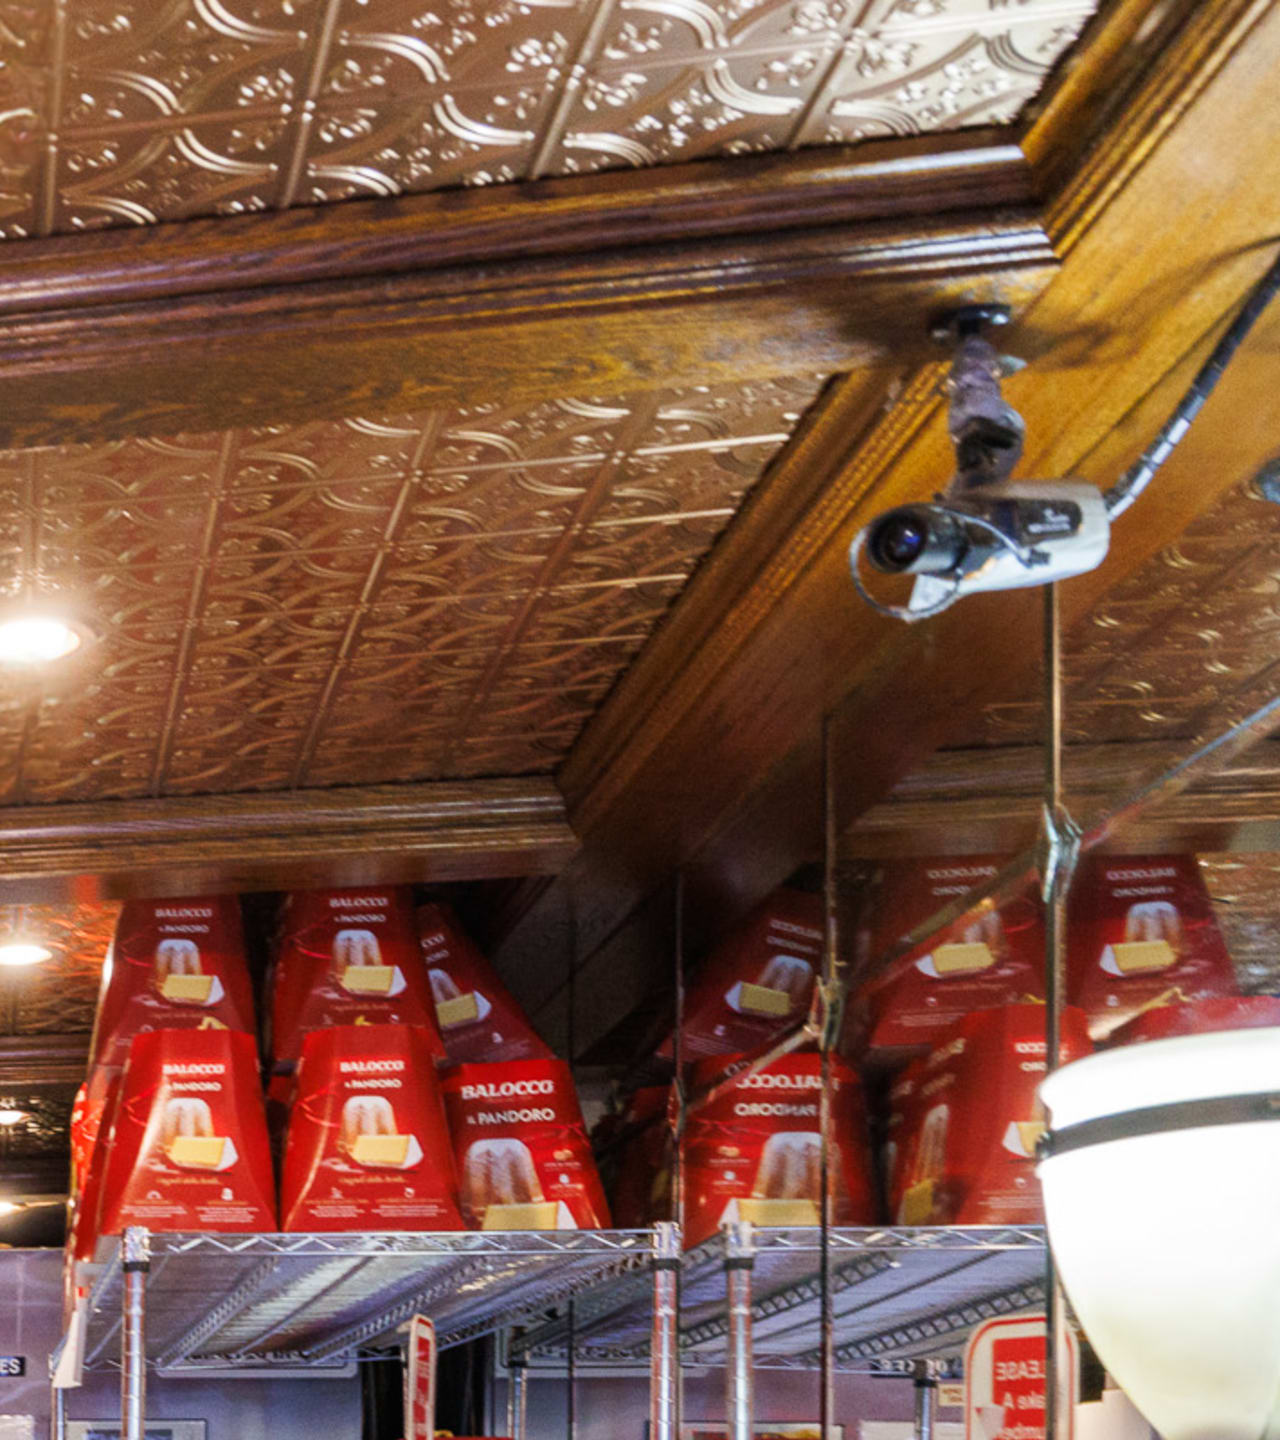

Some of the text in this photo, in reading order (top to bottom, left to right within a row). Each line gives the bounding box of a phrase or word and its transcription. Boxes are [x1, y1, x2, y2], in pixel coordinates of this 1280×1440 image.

[330, 897, 388, 908] BALOCCO
[155, 908, 212, 918] BALOCCO
[342, 913, 386, 923] PANDORO
[168, 923, 209, 933] PANDORO
[163, 1063, 225, 1075] BALOCCO
[340, 1060, 404, 1072] BALOCCO
[172, 1081, 221, 1092] PANDORO
[351, 1078, 401, 1089] PANDORO
[461, 1080, 555, 1100] BALOCCO
[478, 1107, 555, 1125] PANDORO
